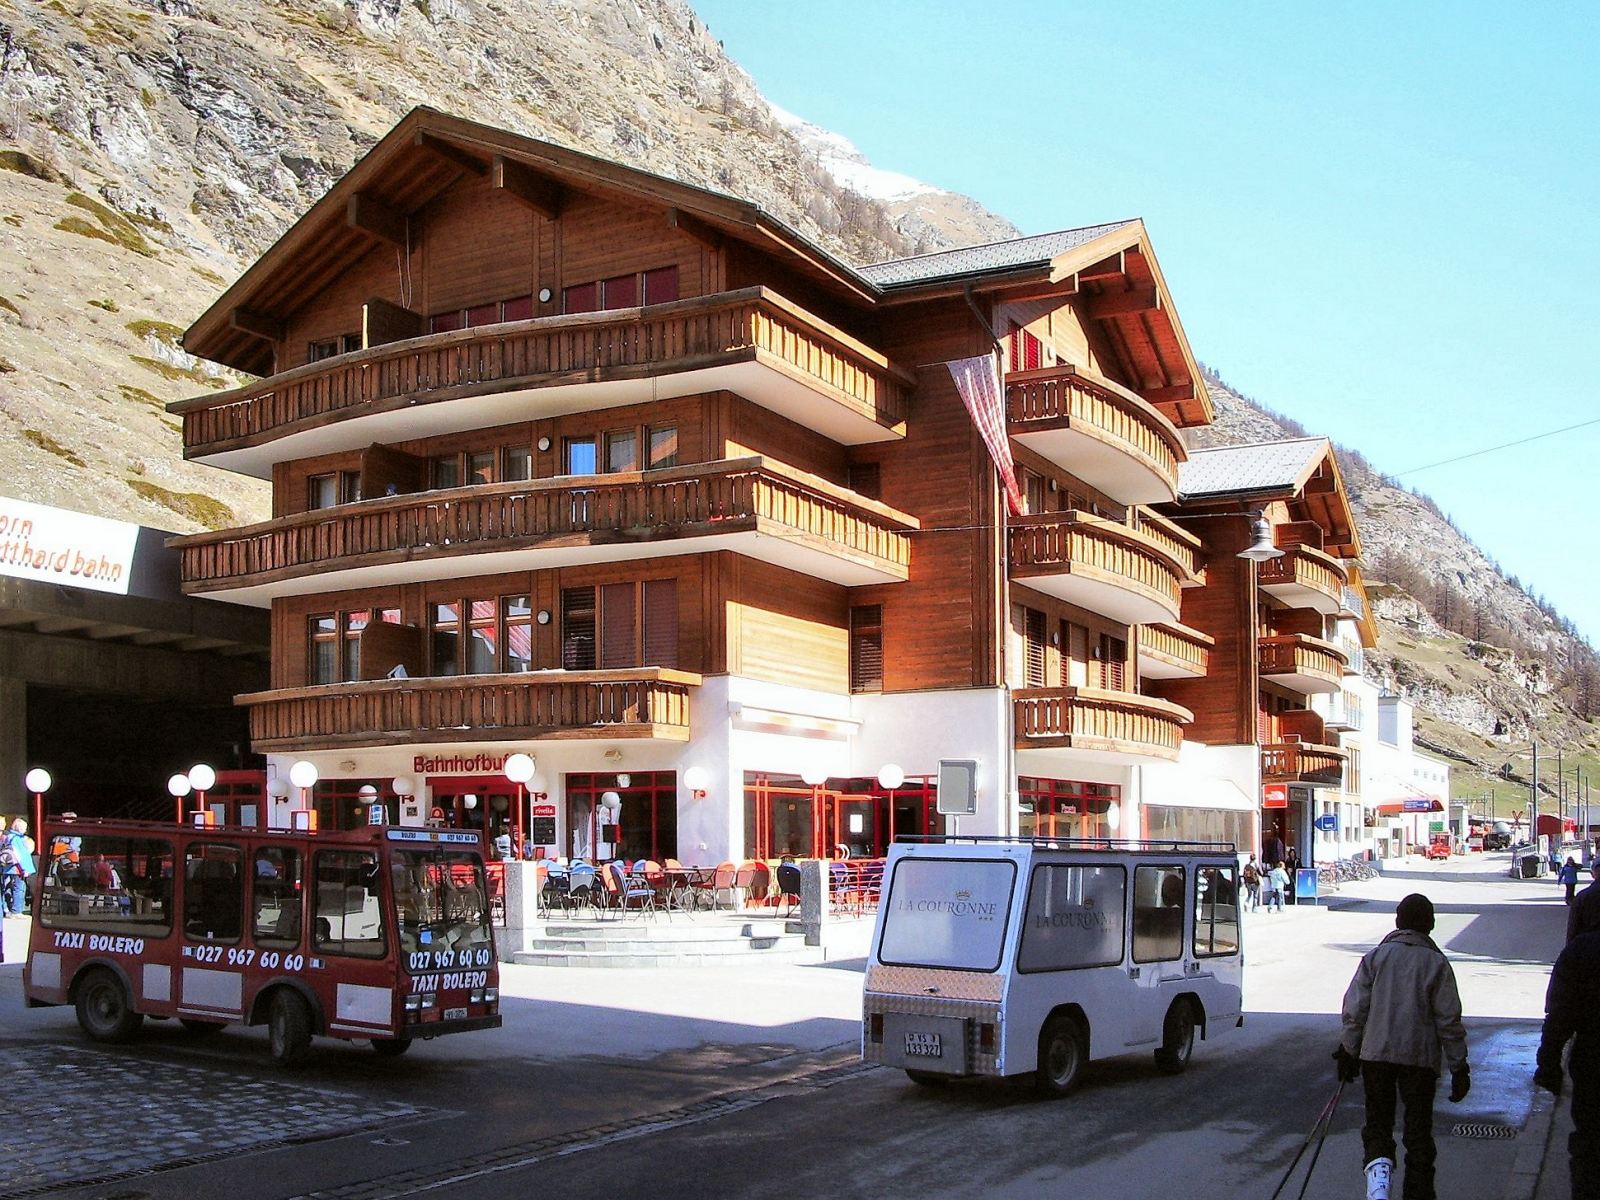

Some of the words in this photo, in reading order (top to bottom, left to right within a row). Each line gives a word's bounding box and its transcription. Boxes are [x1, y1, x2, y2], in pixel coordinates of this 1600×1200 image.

[0, 541, 70, 573] tthard
[413, 752, 535, 773] Bahnhofbuf
[899, 899, 913, 912] LA
[917, 899, 997, 917] COURONNE
[54, 931, 85, 949] TAXI
[89, 934, 145, 955] BOLERO
[196, 945, 223, 963] 027
[228, 947, 255, 966] 967
[260, 951, 279, 968] 60
[284, 954, 304, 971] 60
[410, 951, 431, 969] 027
[434, 950, 455, 969] 967
[459, 949, 472, 967] 60
[476, 949, 489, 965] 60
[411, 974, 439, 993] TAXI
[442, 971, 487, 990] BOLERO
[917, 1034, 927, 1043] VS
